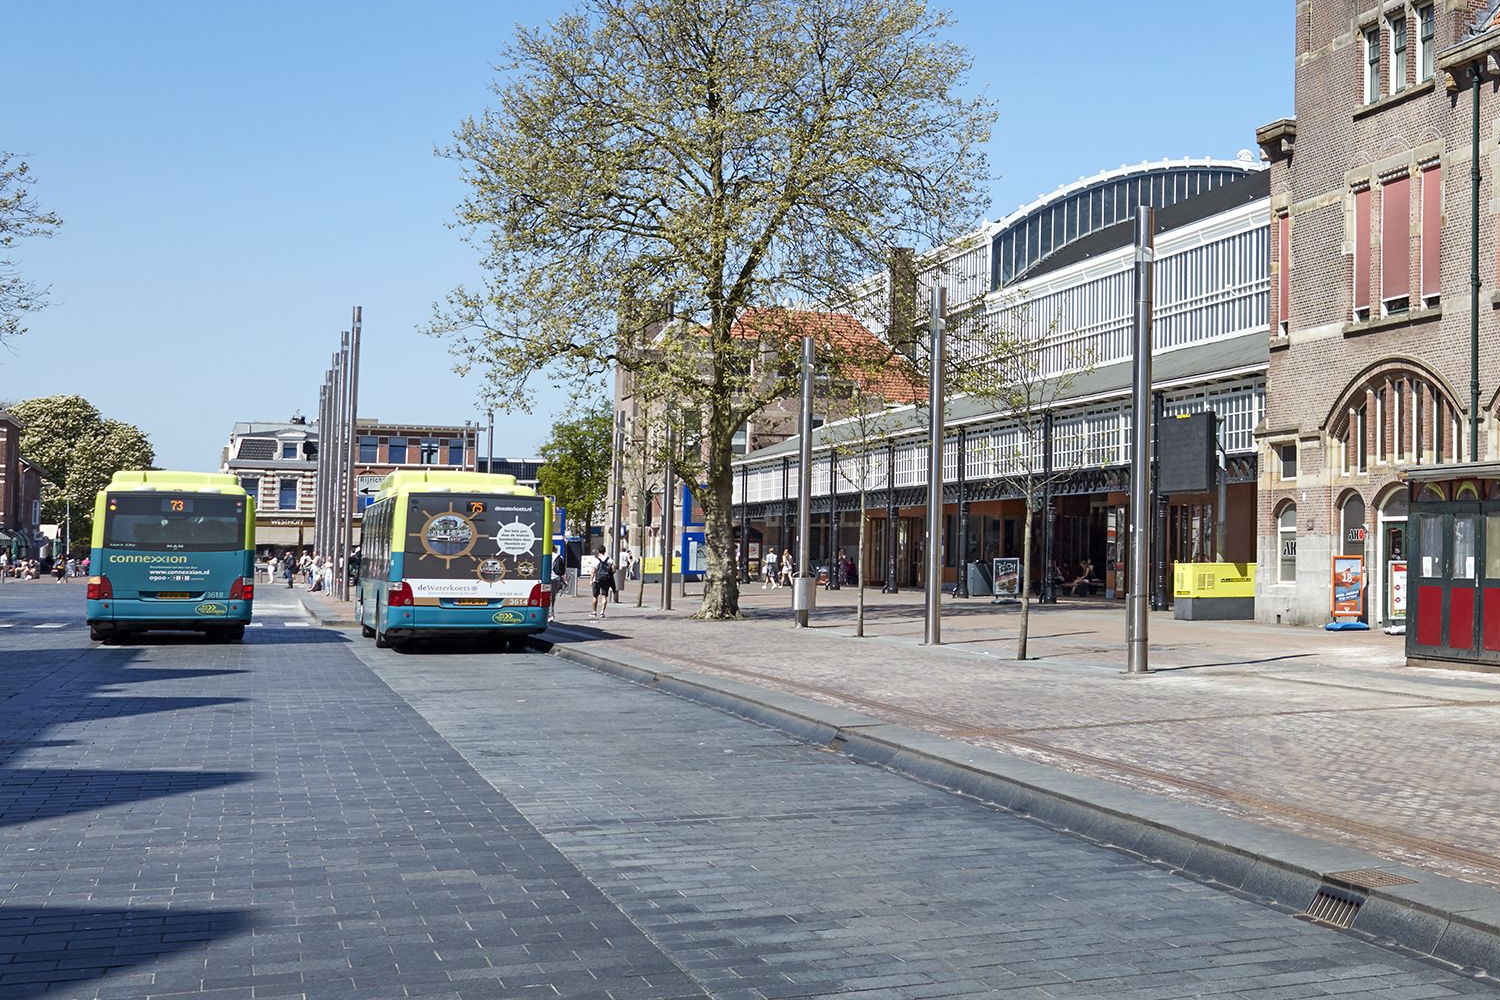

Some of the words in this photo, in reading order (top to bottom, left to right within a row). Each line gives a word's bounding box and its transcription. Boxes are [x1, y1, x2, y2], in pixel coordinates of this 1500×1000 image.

[170, 500, 184, 512] 73
[470, 502, 483, 513] 75
[109, 554, 187, 564] connexxion
[206, 591, 223, 599] 3618
